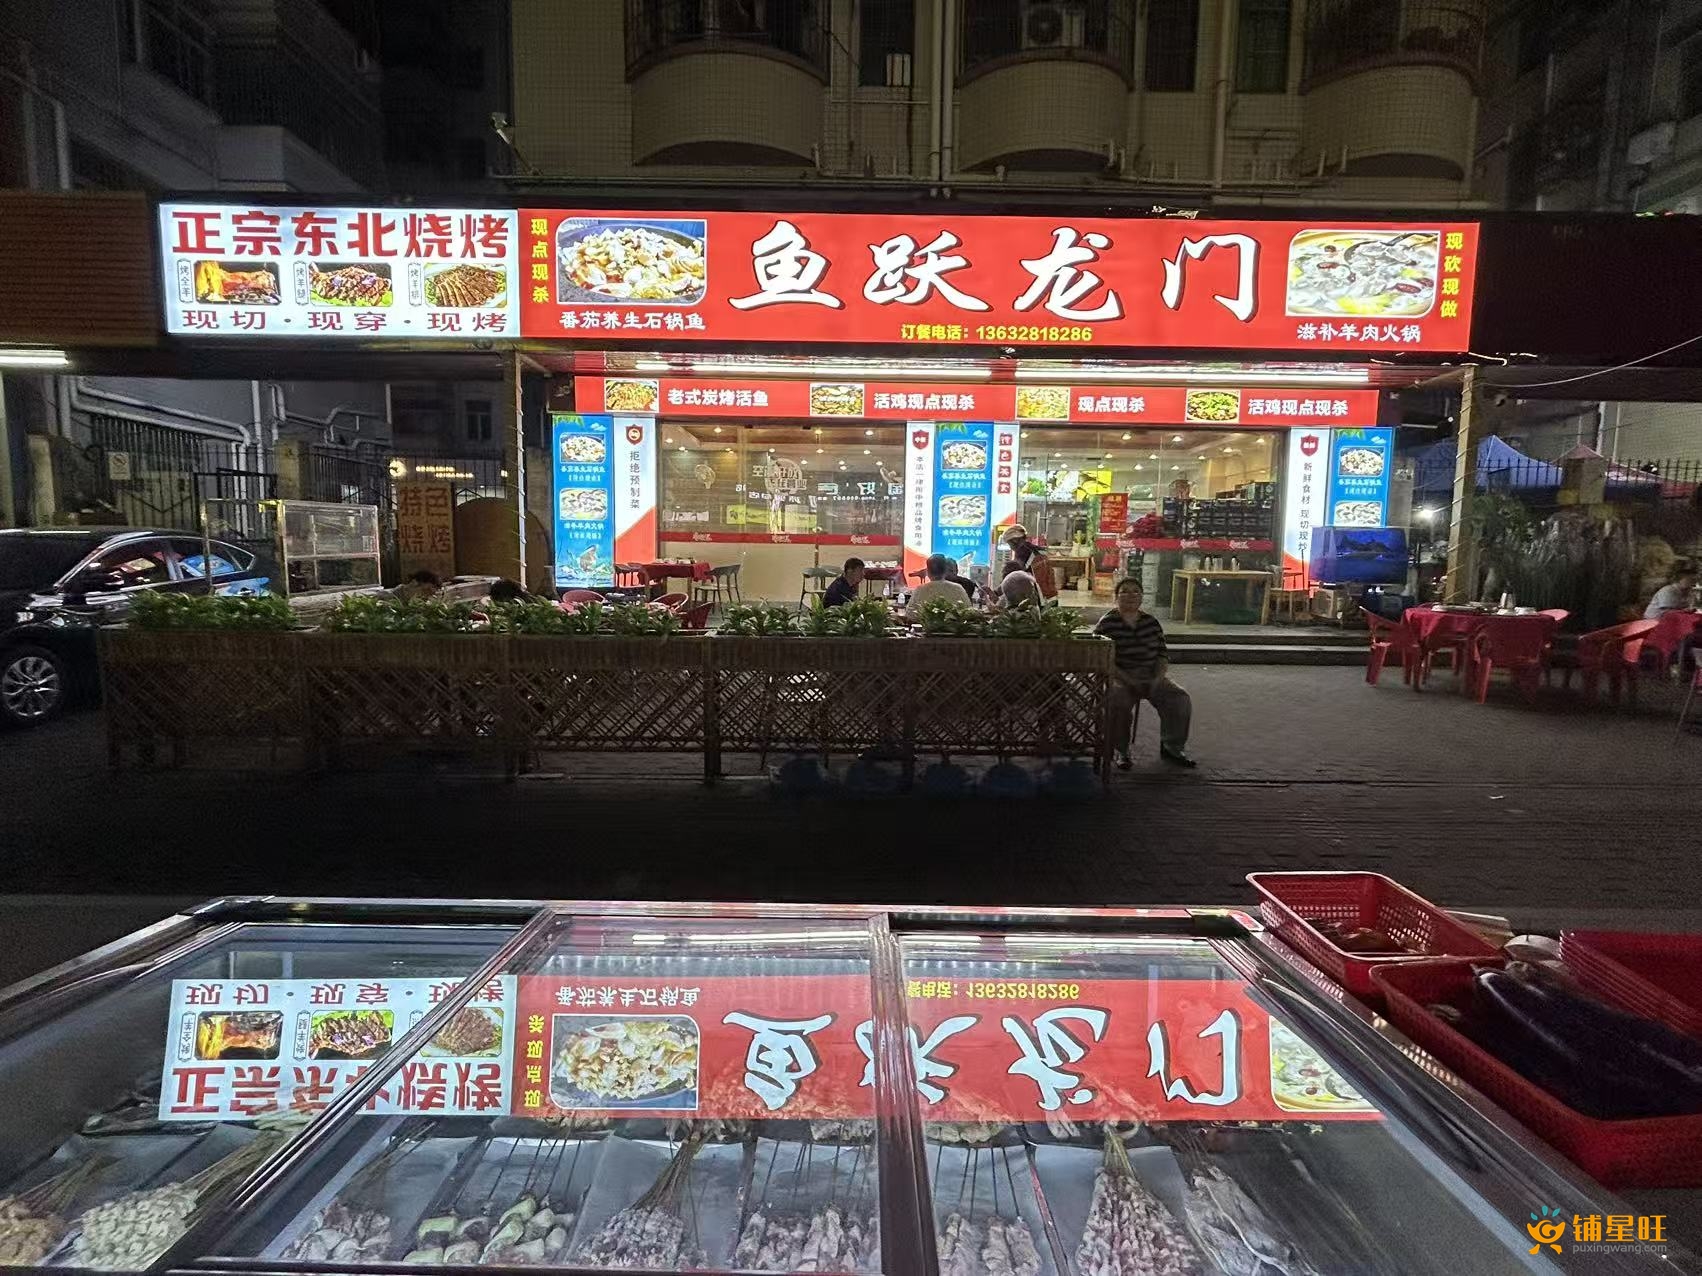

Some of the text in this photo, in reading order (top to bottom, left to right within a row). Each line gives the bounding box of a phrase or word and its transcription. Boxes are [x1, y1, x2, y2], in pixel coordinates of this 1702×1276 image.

[172, 210, 510, 259] 正宗东北烧烤
[530, 218, 550, 304] 现点现杀
[729, 219, 1260, 322] 鱼跃龙门
[1440, 230, 1464, 319] 现砍现做
[179, 265, 192, 297] 烤全羊
[558, 310, 706, 331] 番茄养生石锅鱼
[1296, 322, 1422, 343] 滋补羊肉火锅
[668, 389, 769, 408] 老式炭烤活鱼
[873, 392, 976, 411] 活鸡现点现杀
[1077, 396, 1146, 413] 现点现杀
[1247, 398, 1349, 416] 活鸡现点现杀
[629, 451, 641, 509] 拒绝预制菜
[1301, 462, 1312, 505] 新鲜食材
